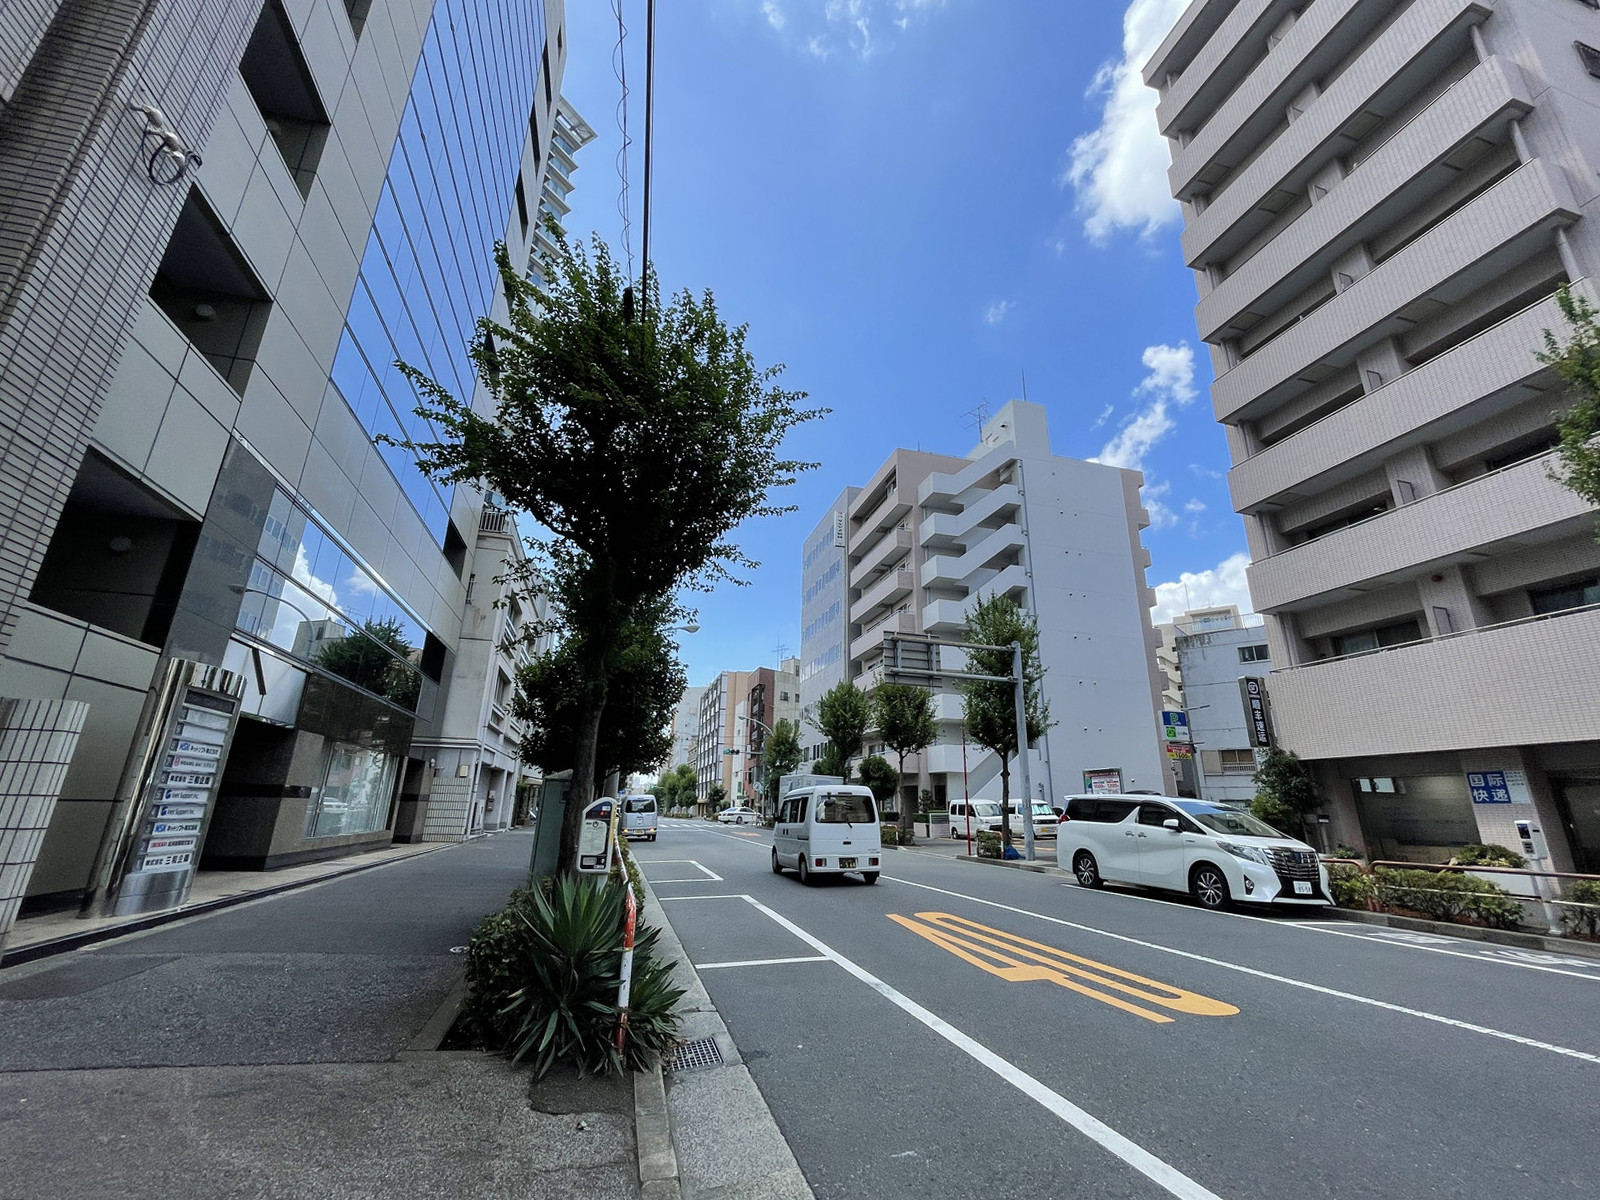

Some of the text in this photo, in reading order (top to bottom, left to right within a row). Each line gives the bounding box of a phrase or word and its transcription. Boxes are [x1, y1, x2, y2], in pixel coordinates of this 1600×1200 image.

[170, 774, 187, 782] 株式会社
[1468, 774, 1504, 787] 国际
[1473, 788, 1510, 802] 快递
[145, 858, 163, 866] 株式会社
